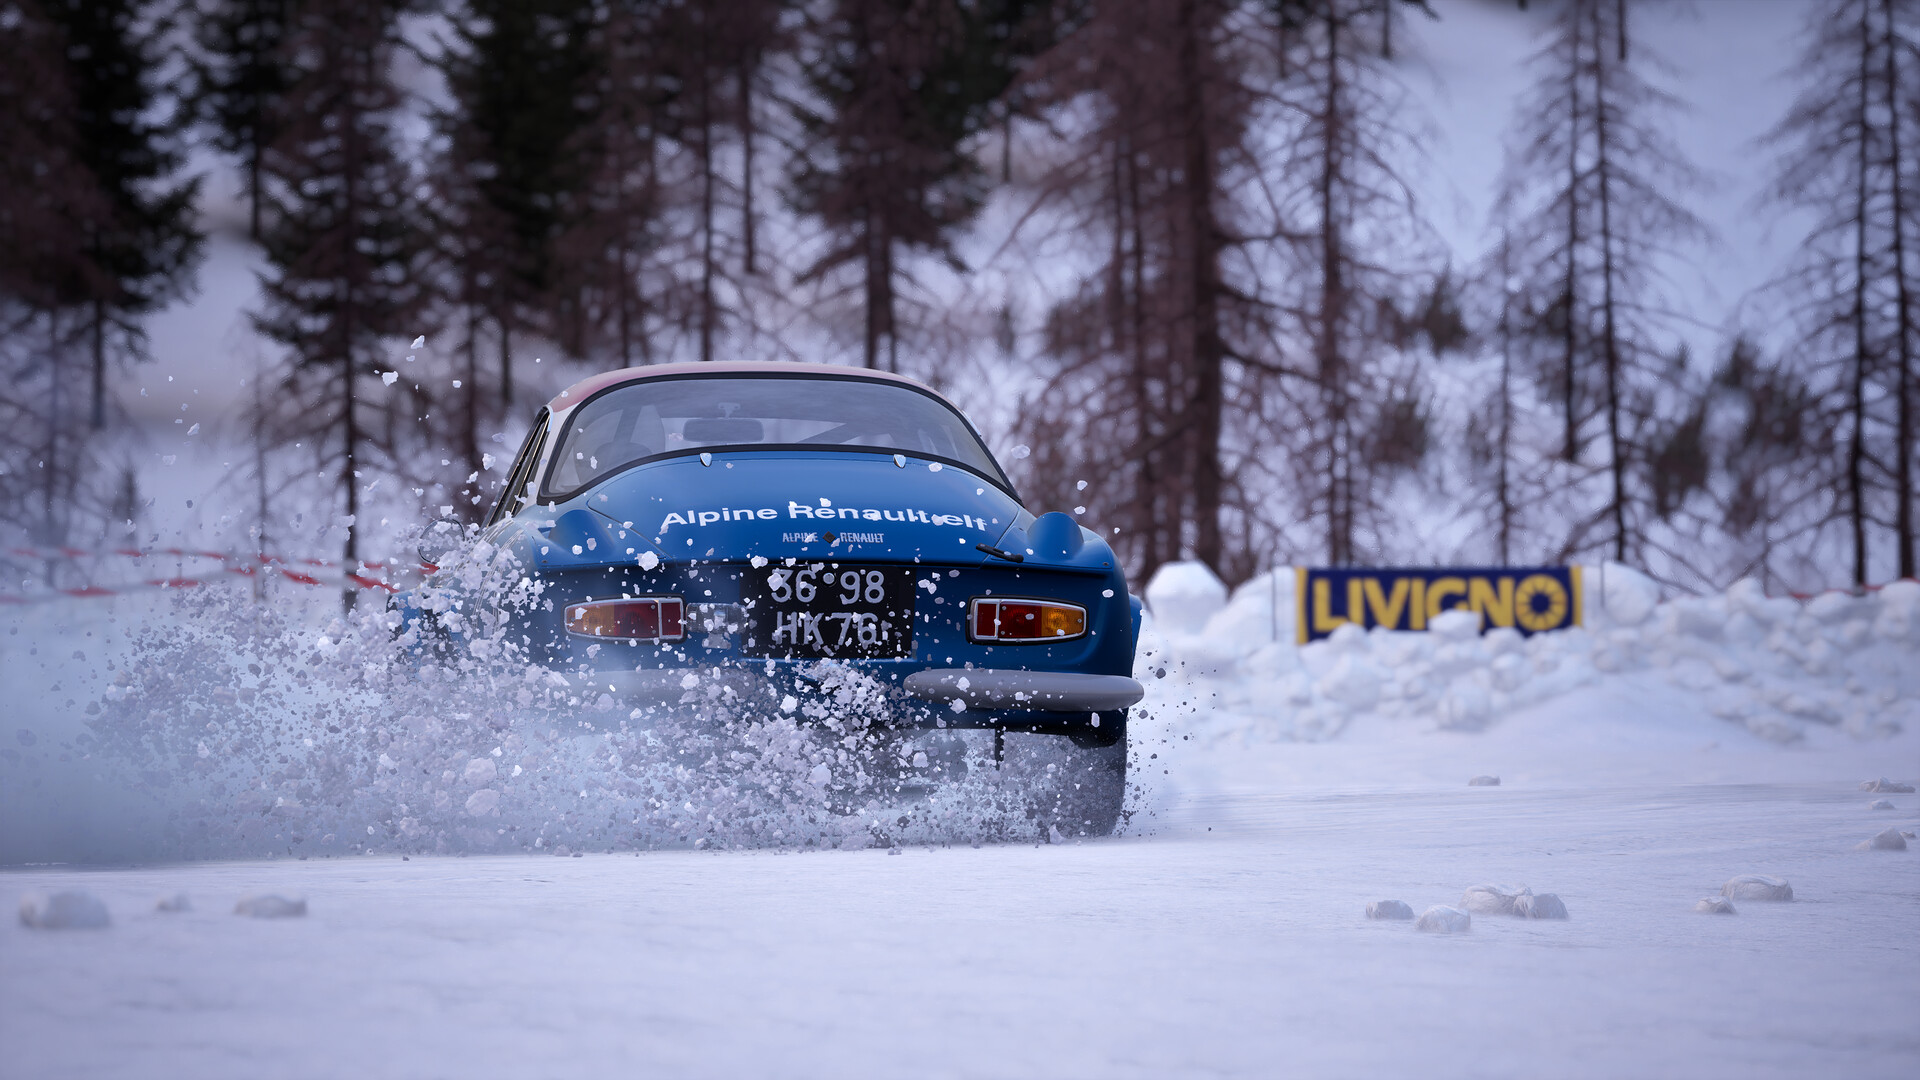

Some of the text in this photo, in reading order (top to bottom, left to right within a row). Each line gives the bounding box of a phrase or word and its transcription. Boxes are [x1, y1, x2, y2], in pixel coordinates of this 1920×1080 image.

[662, 505, 987, 532] Alpine Renault elf
[782, 532, 885, 543] ALPINE RENAULT
[771, 568, 885, 605] 36 98
[1312, 574, 1567, 632] LIVIGNO
[775, 611, 879, 646] HK 76
